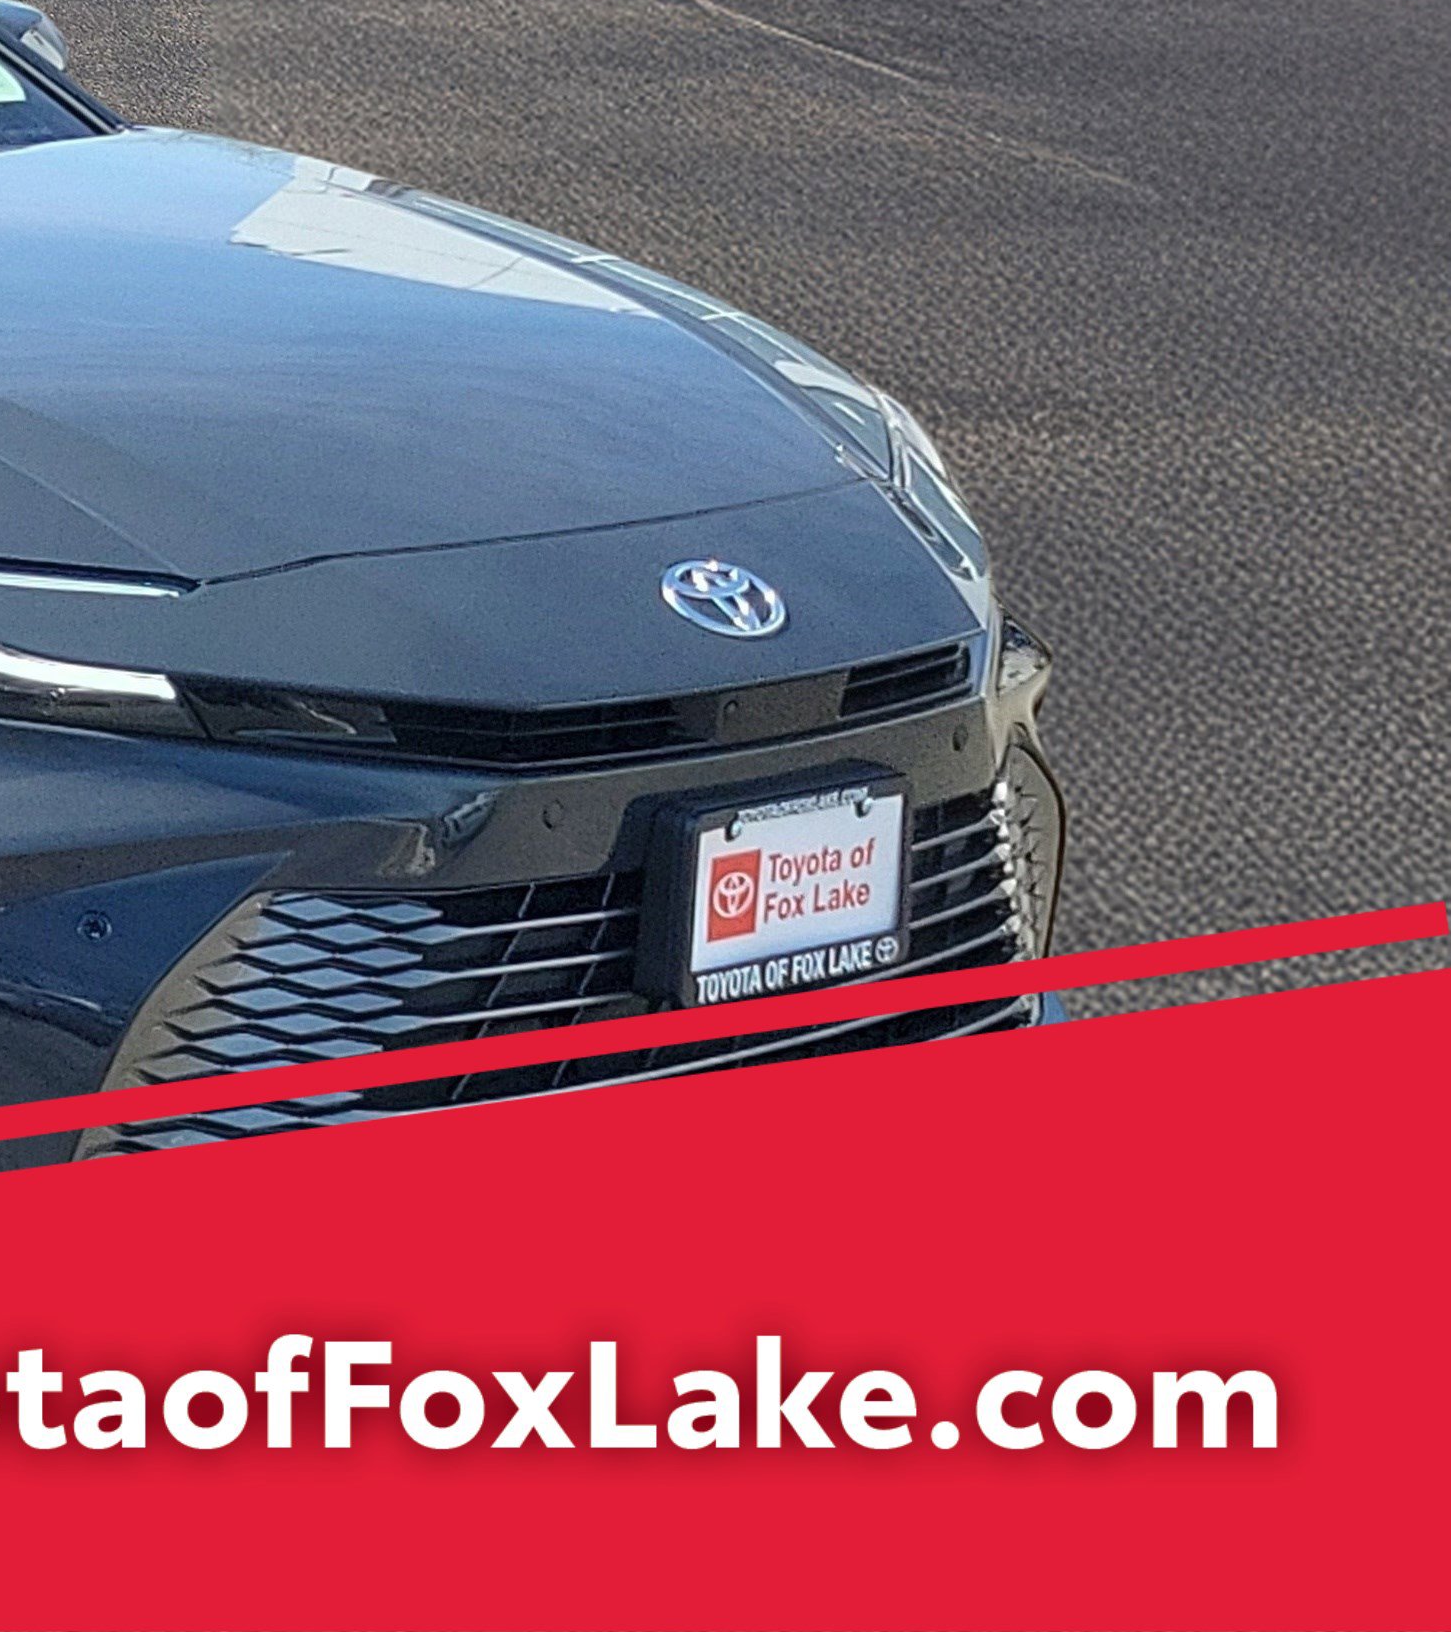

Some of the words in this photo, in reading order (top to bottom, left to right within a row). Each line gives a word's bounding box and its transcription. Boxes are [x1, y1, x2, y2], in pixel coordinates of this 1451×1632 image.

[768, 845, 842, 887] Toyota
[850, 837, 876, 868] of
[763, 891, 805, 924] Fox
[813, 879, 871, 913] Lake
[697, 964, 763, 1004] TOYOTA
[765, 958, 789, 990] OF
[791, 947, 827, 985] FOX
[828, 939, 874, 976] LAKE
